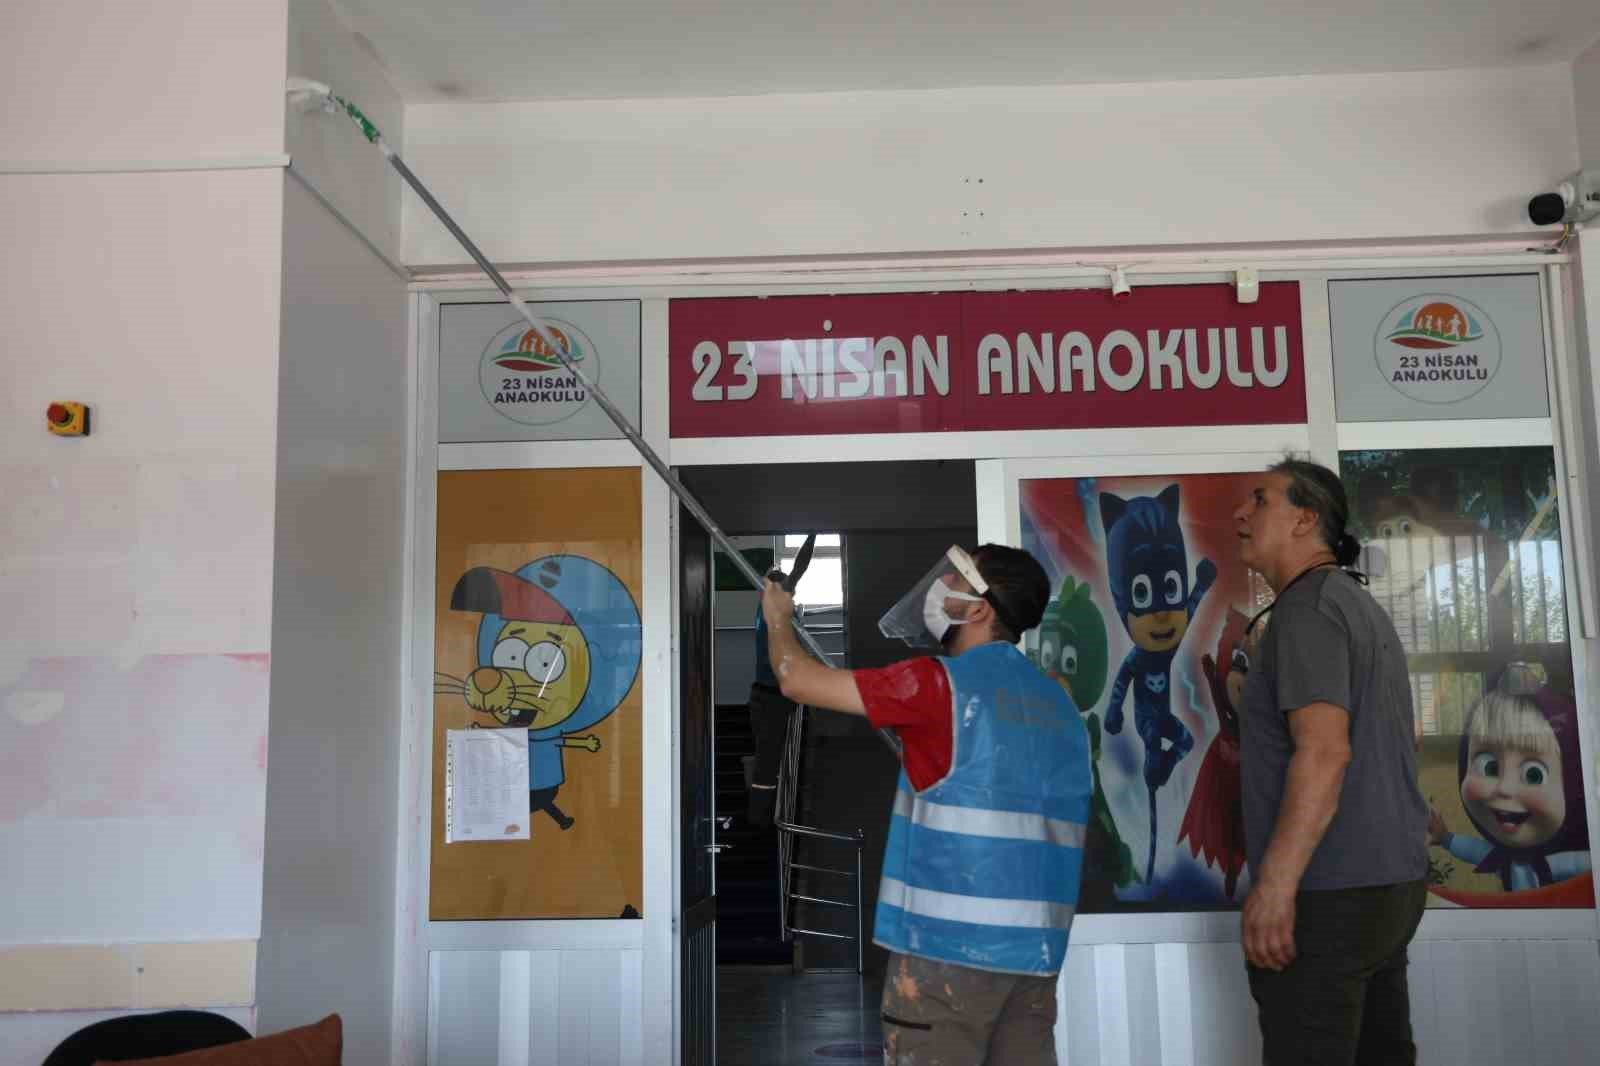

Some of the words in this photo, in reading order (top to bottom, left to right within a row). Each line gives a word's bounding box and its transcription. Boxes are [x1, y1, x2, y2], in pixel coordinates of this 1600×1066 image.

[691, 341, 758, 402] 23
[780, 319, 950, 400] NİSAN
[977, 325, 1289, 396] ANAOKULU
[1400, 356, 1419, 368] 23
[1425, 353, 1478, 367] NİSAN
[1392, 369, 1488, 382] ANAOKULU
[502, 378, 521, 390] 23
[526, 376, 577, 389] NİSAN
[494, 390, 585, 404] ANAOKULU
